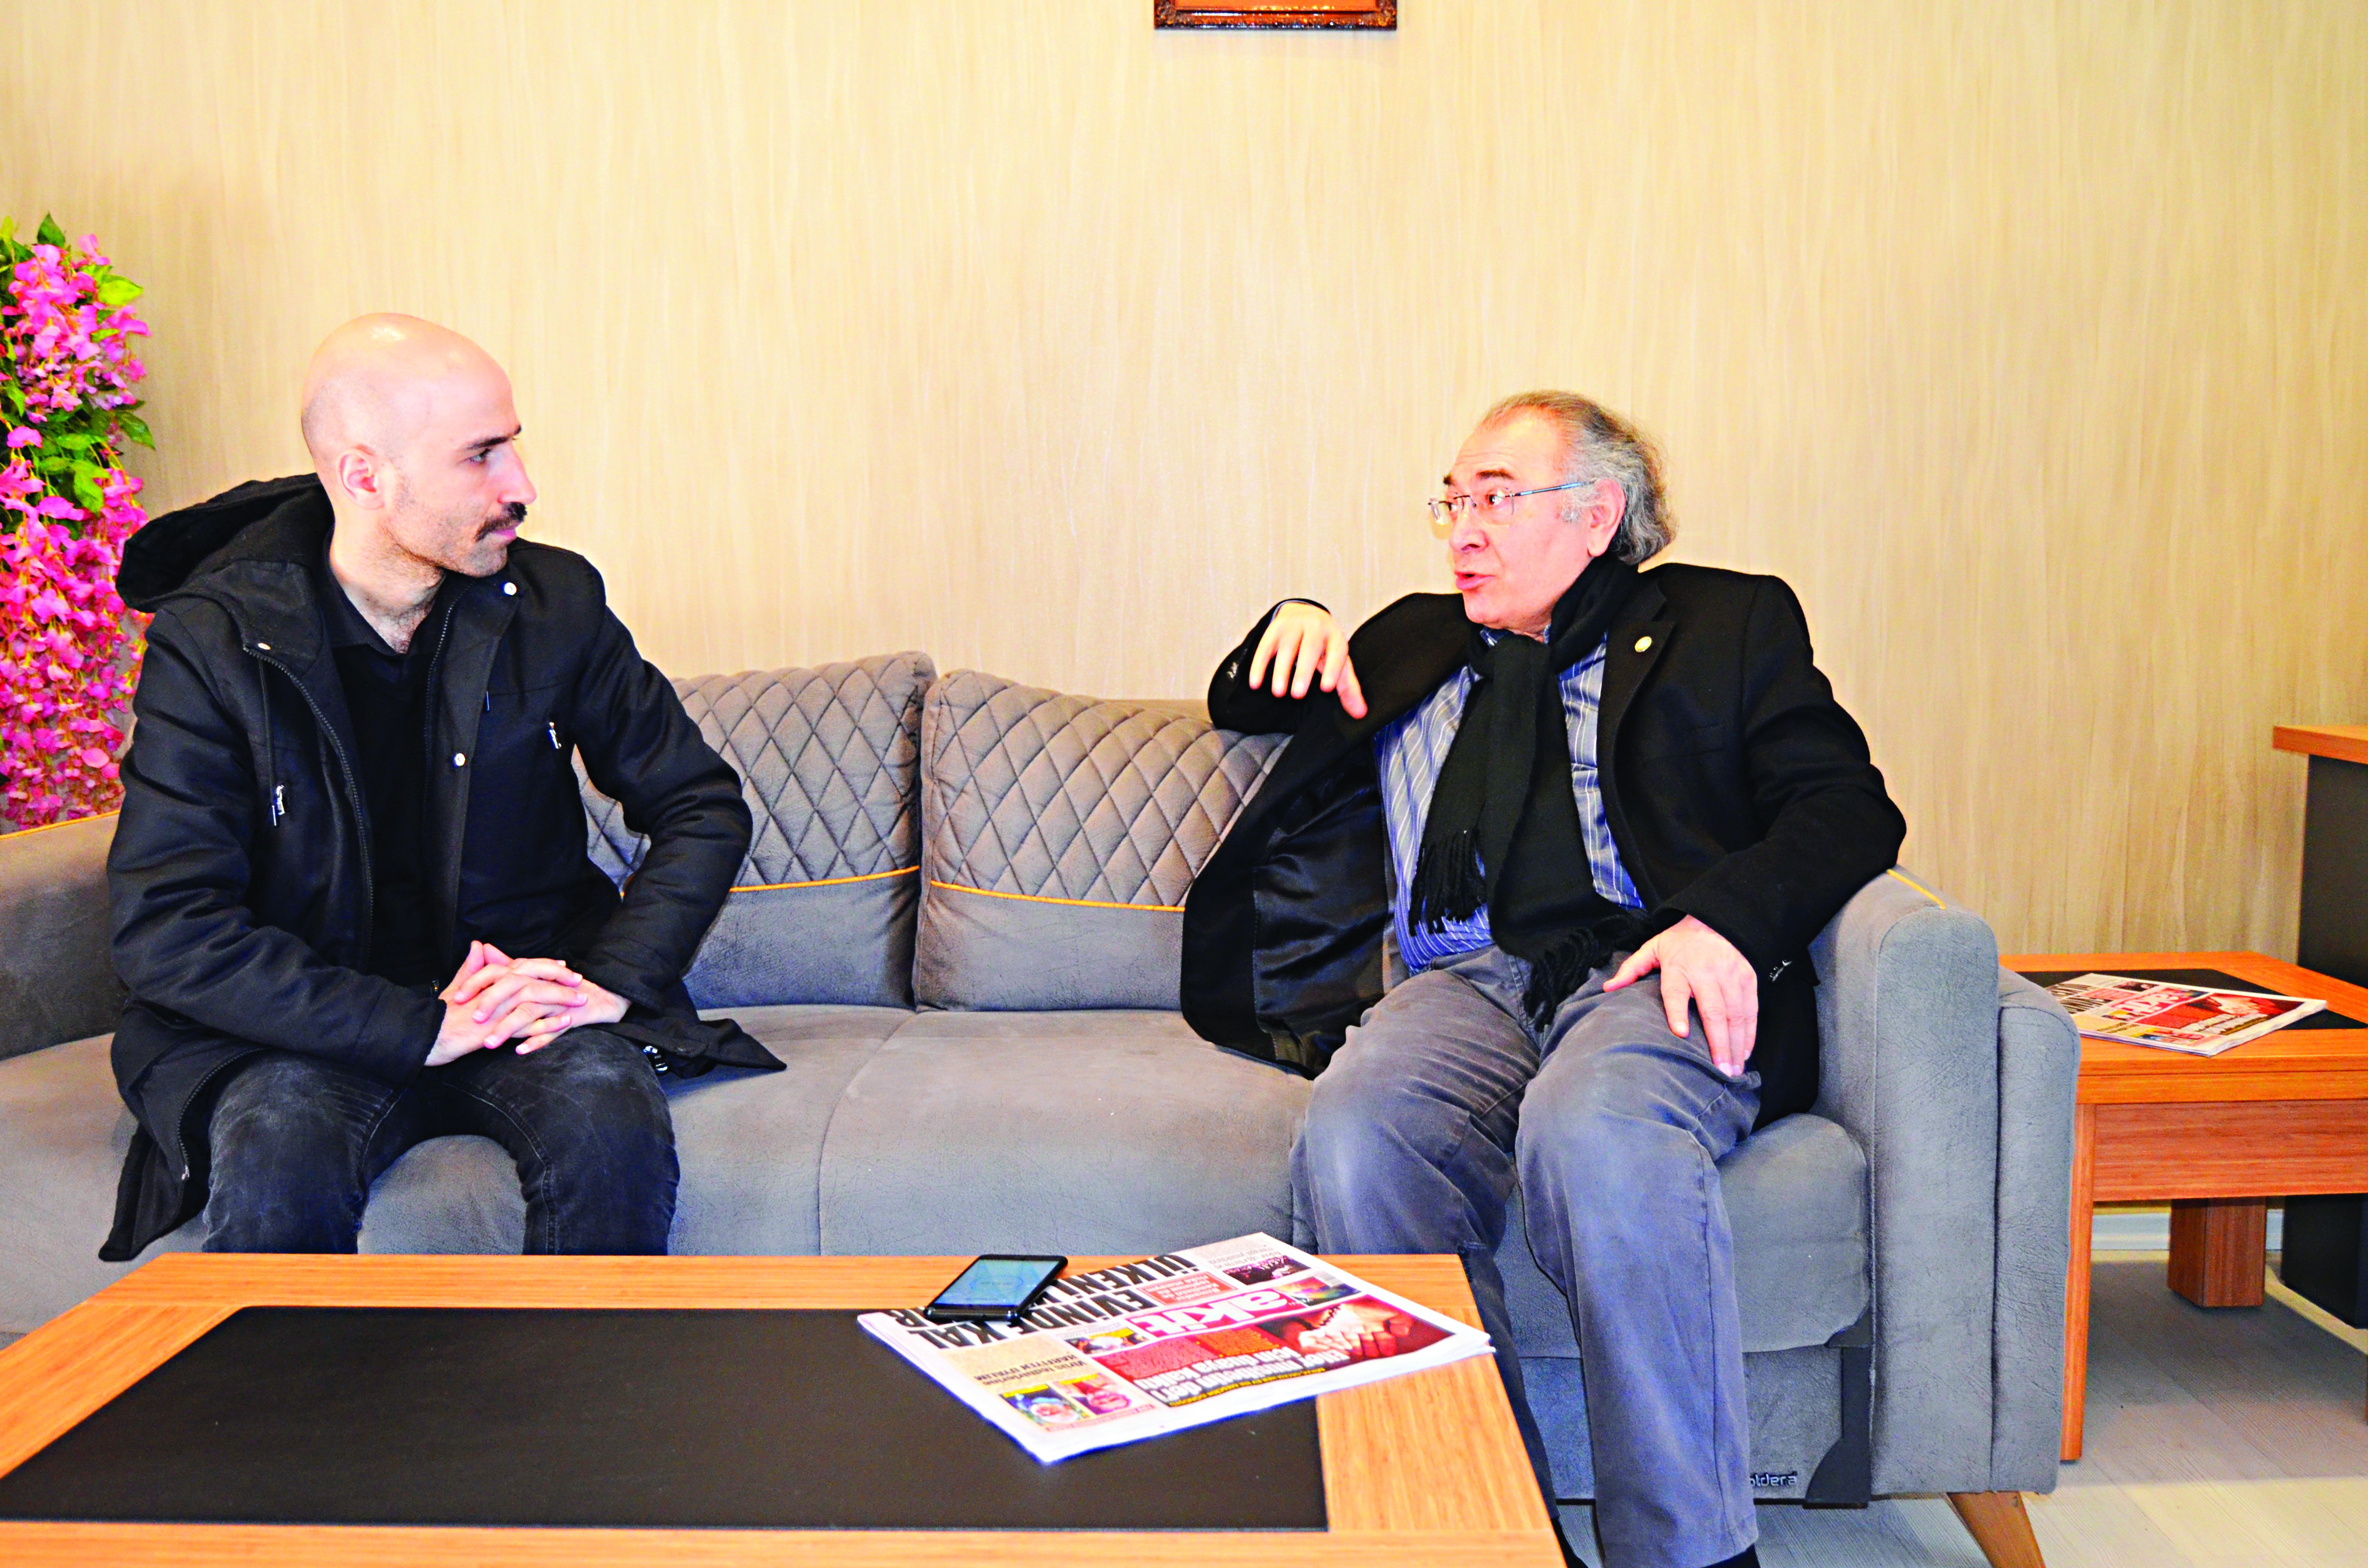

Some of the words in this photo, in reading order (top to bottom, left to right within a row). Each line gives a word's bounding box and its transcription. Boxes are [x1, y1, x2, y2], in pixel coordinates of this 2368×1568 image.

[1128, 1292, 1291, 1335] akit
[906, 1320, 1008, 1350] KAL
[1189, 1354, 1262, 1374] duaya
[1291, 1348, 1352, 1368] Eller
[1130, 1366, 1203, 1391] kalktı
[1192, 1360, 1305, 1389] musibetin
